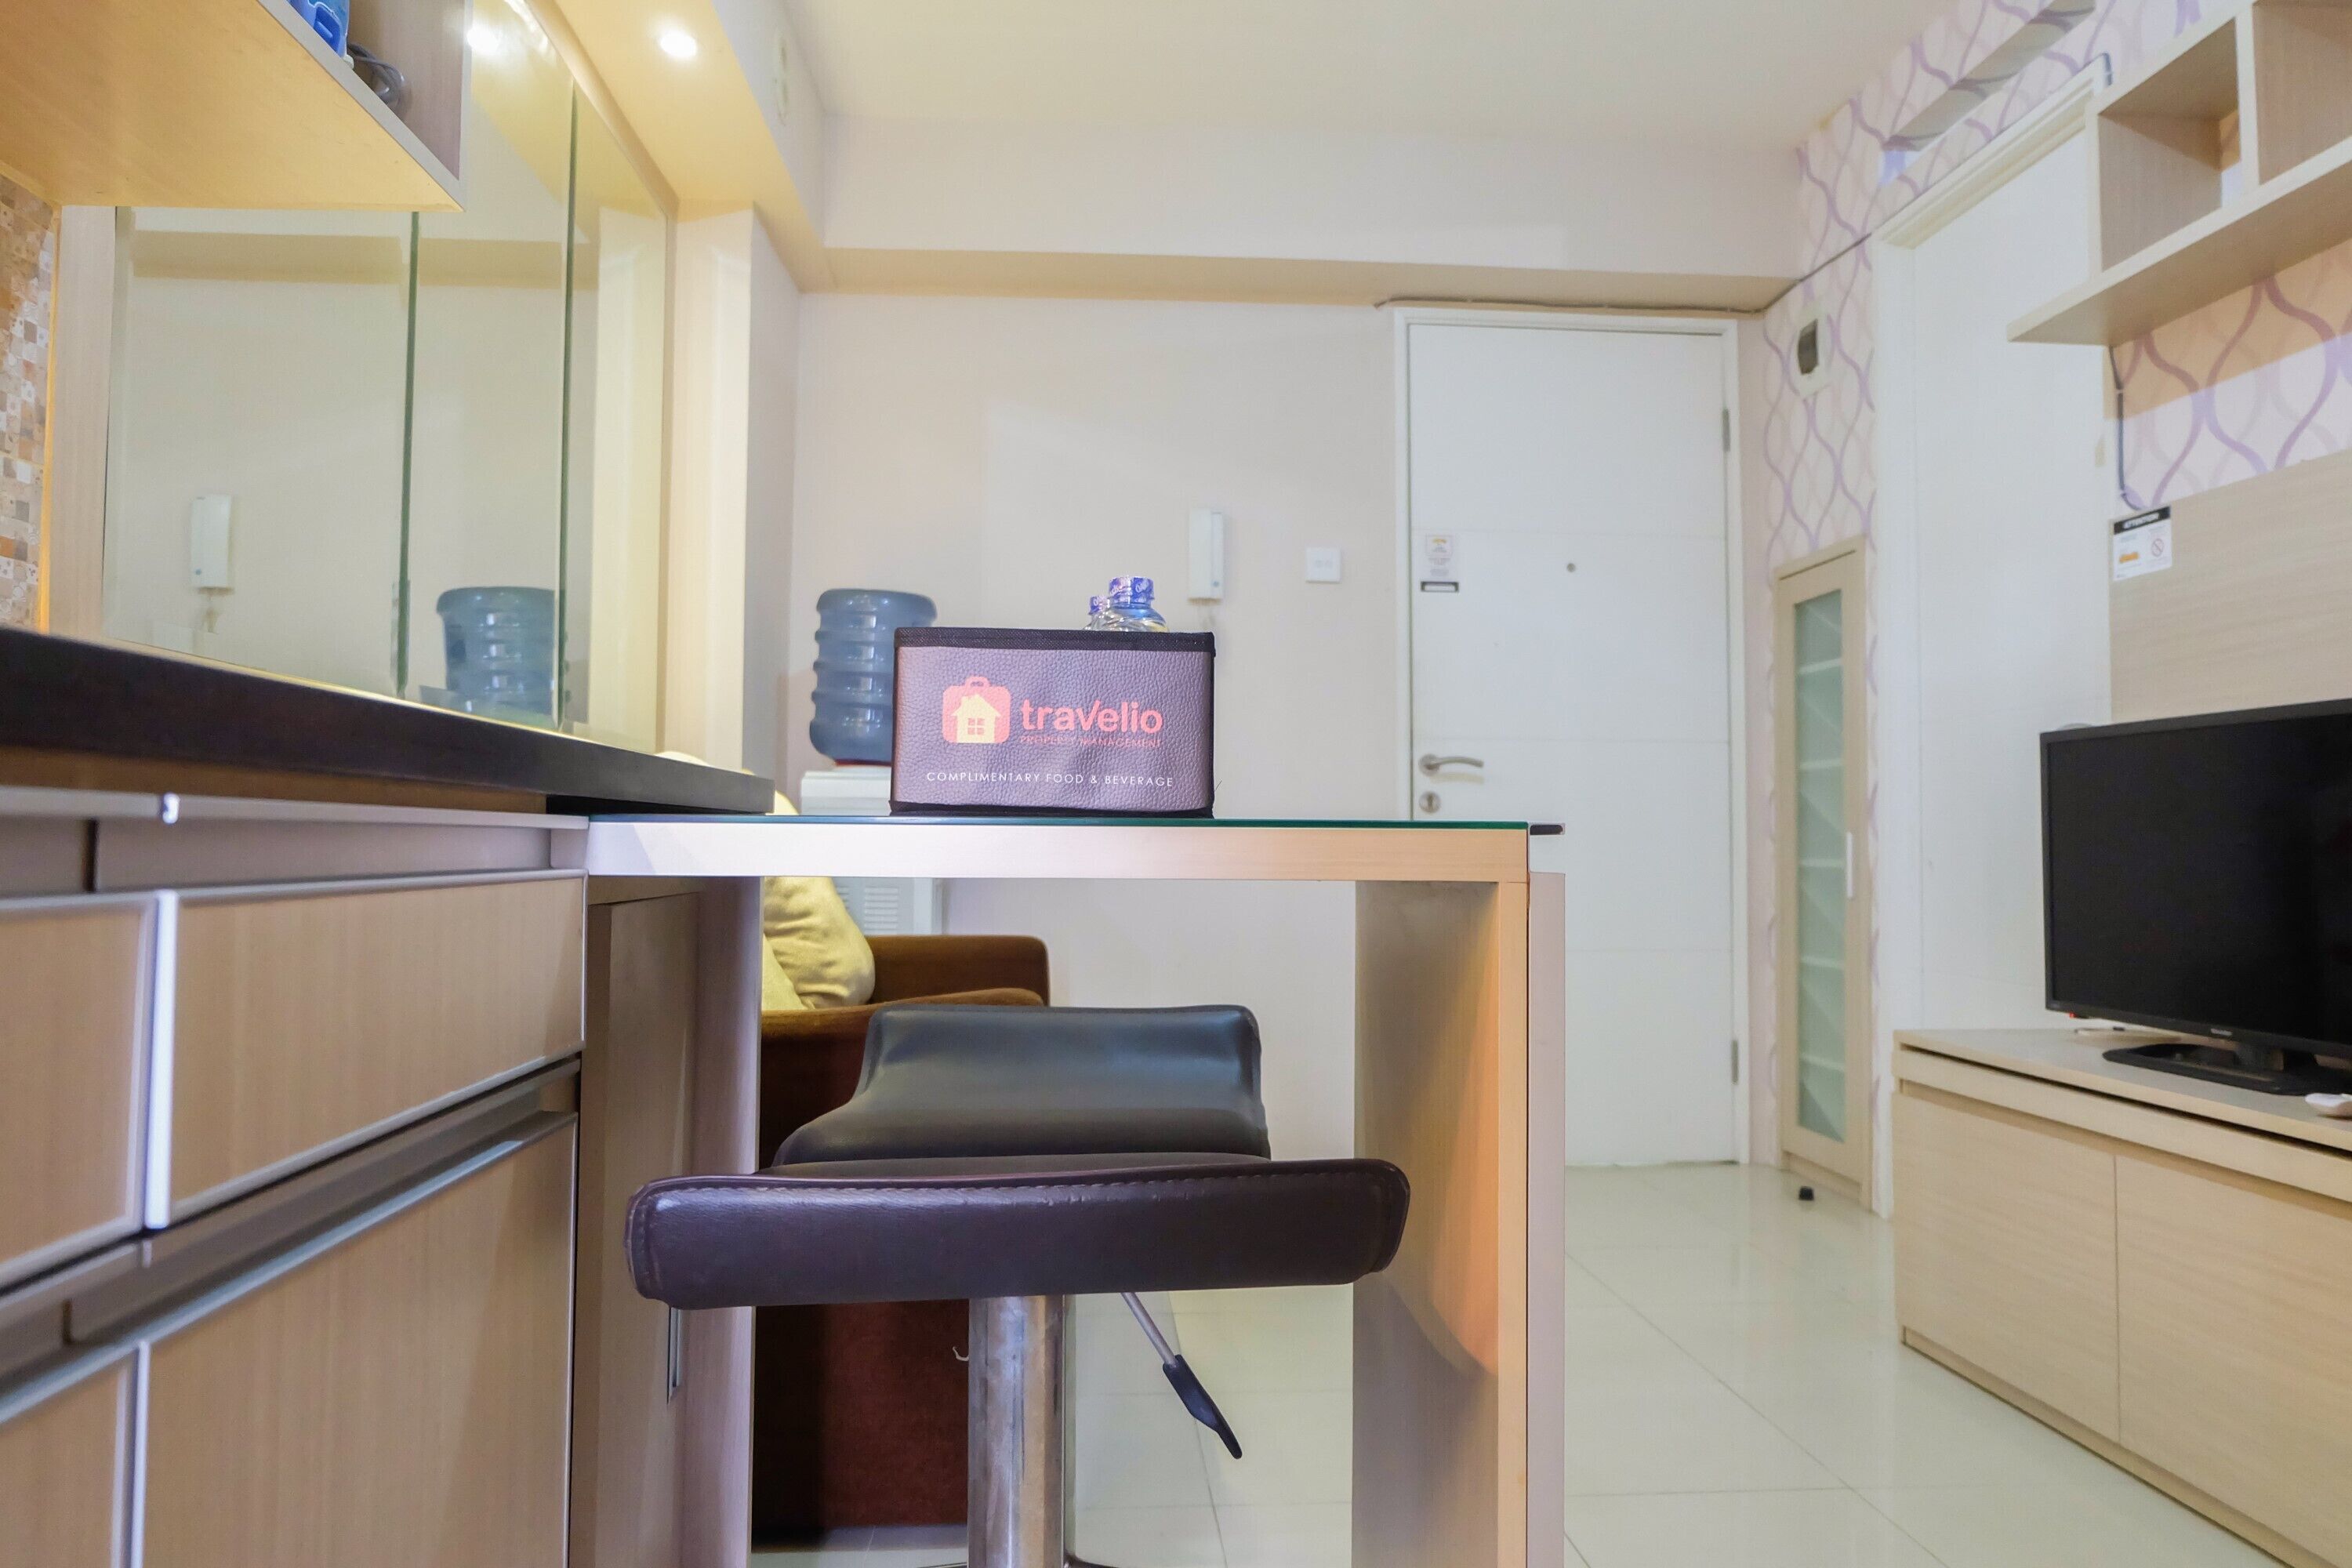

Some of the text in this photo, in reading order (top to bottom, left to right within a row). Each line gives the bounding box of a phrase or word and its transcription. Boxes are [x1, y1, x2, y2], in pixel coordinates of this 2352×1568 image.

[1021, 699, 1163, 734] travelio
[1080, 736, 1162, 748] MANAGEMENT
[927, 771, 1174, 787] COMPLIMENTARY FOOD & BEVERAGE
